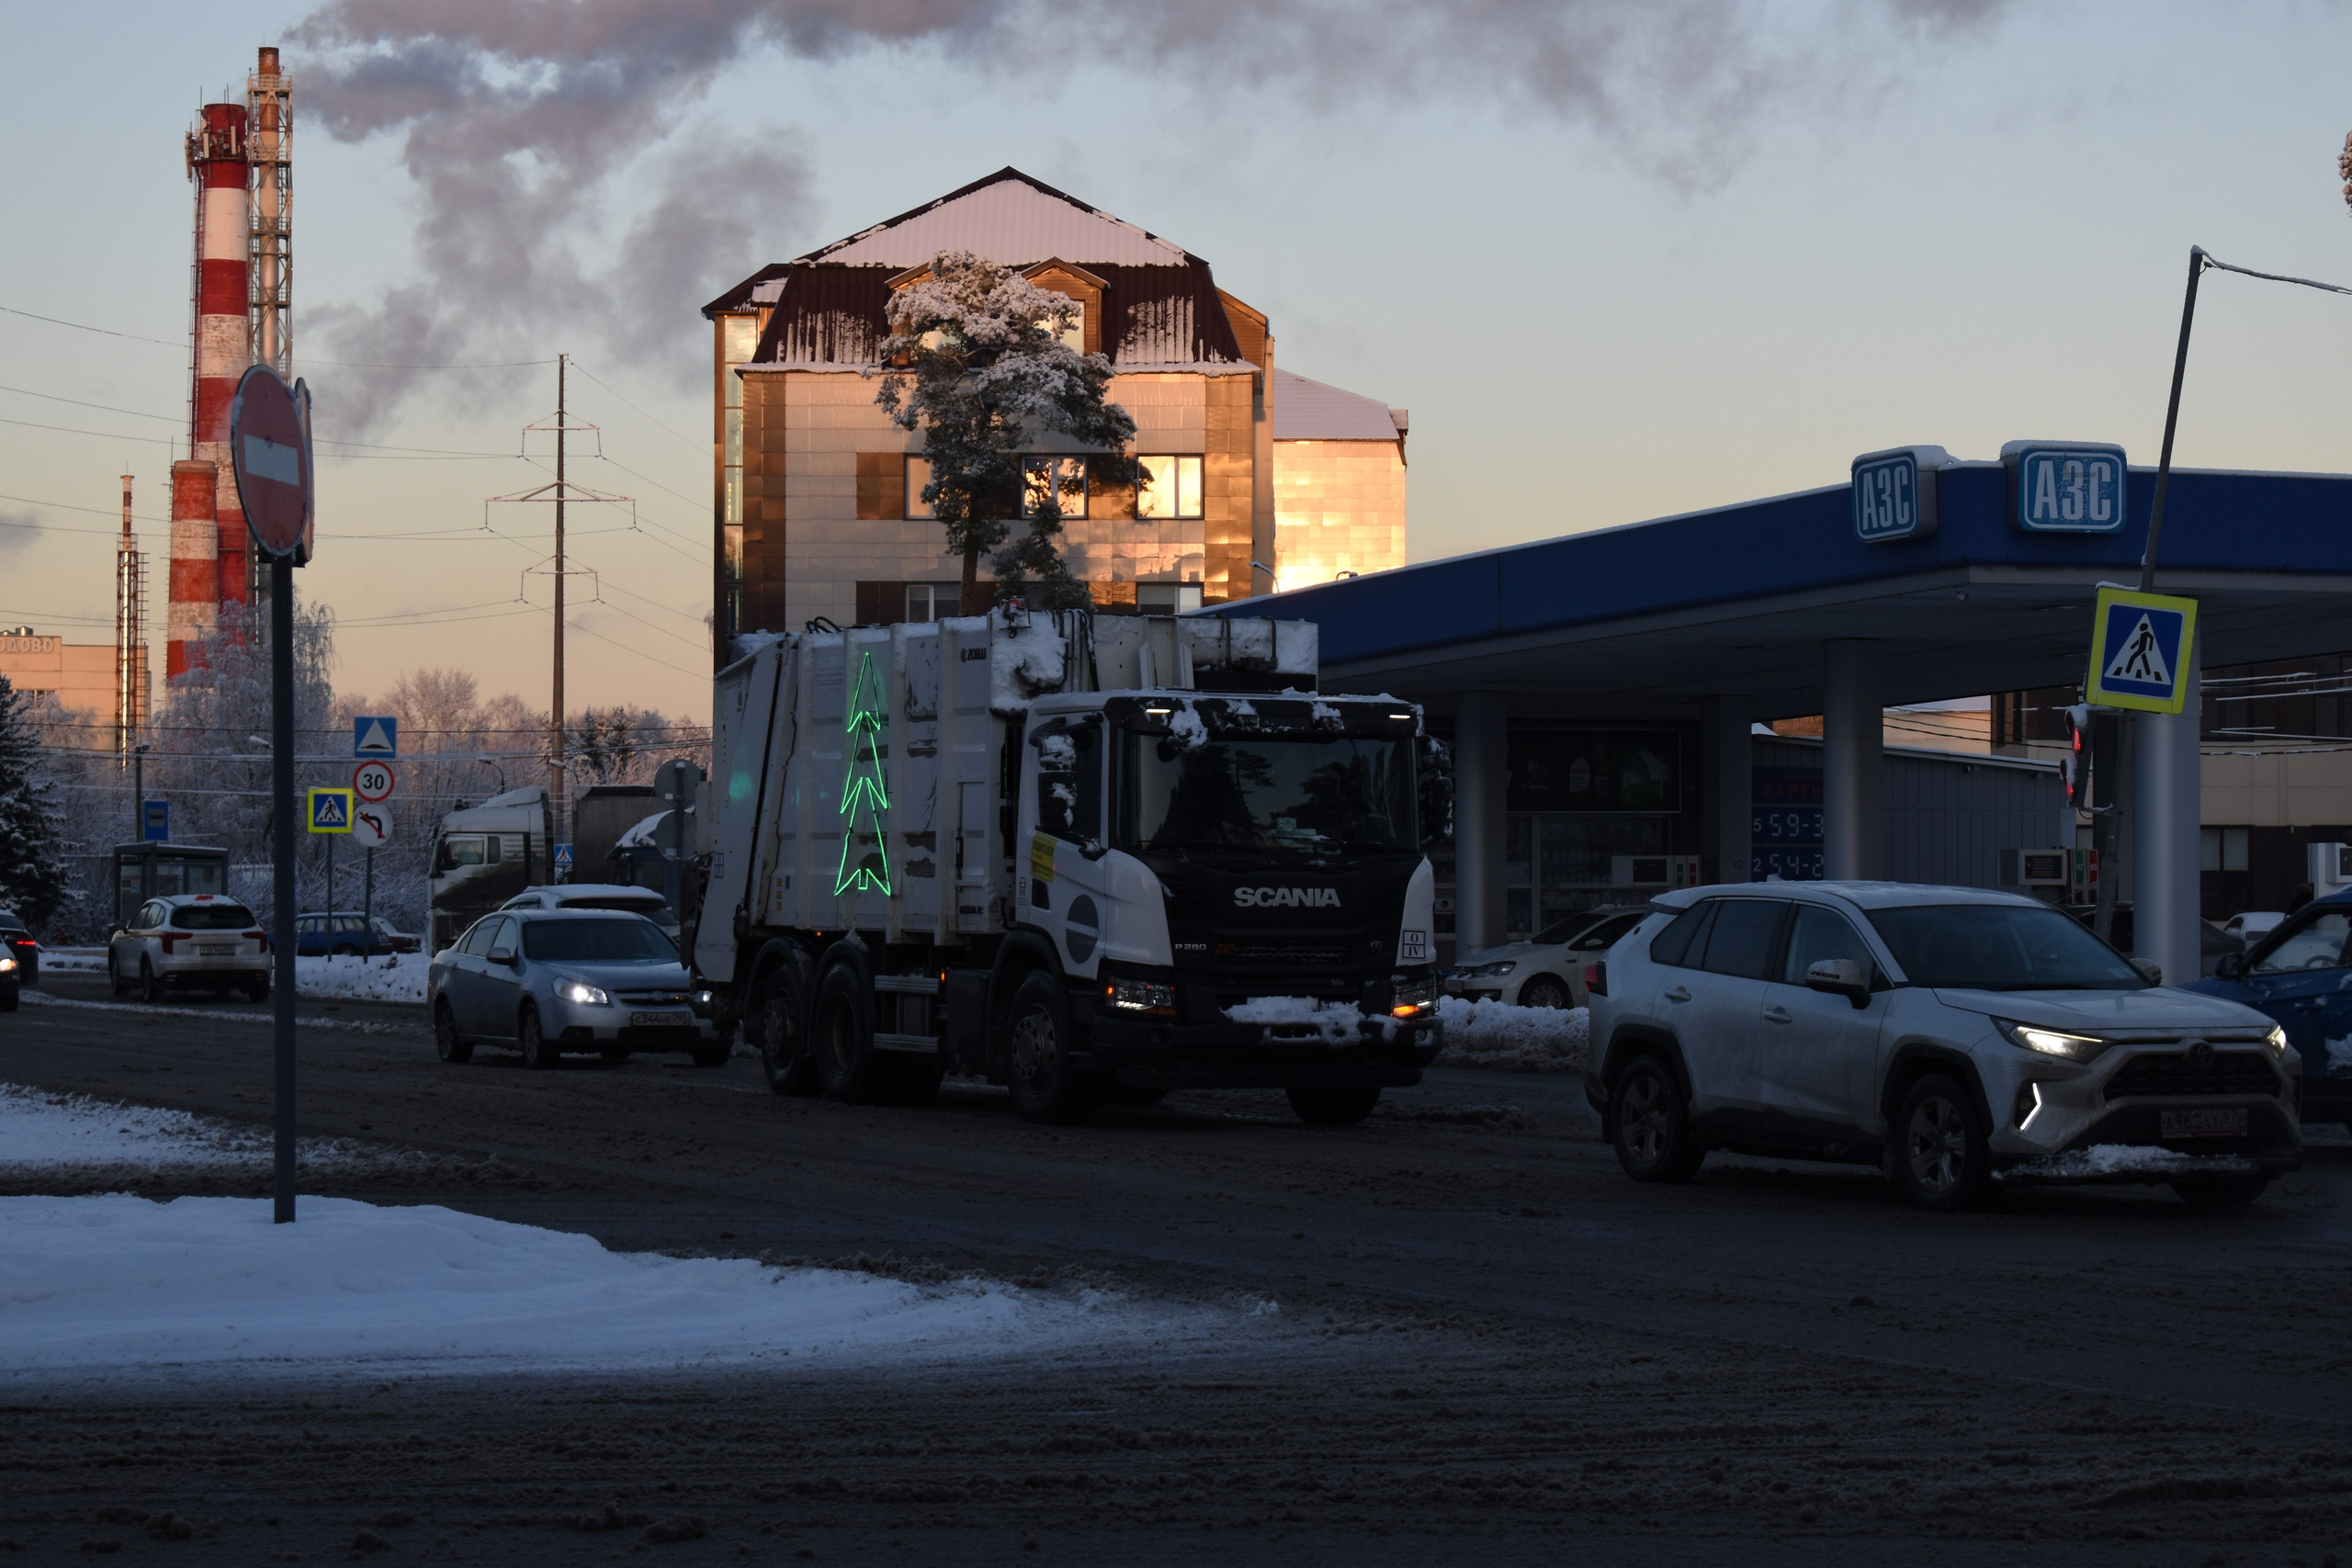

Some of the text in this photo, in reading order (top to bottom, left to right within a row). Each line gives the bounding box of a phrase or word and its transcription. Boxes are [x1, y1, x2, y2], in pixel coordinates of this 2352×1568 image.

[1862, 465, 1910, 531] АЗС
[2033, 460, 2111, 522] АЗС
[363, 773, 384, 790] 30
[1234, 886, 1341, 908] SCANIA
[1408, 946, 1420, 956] IV
